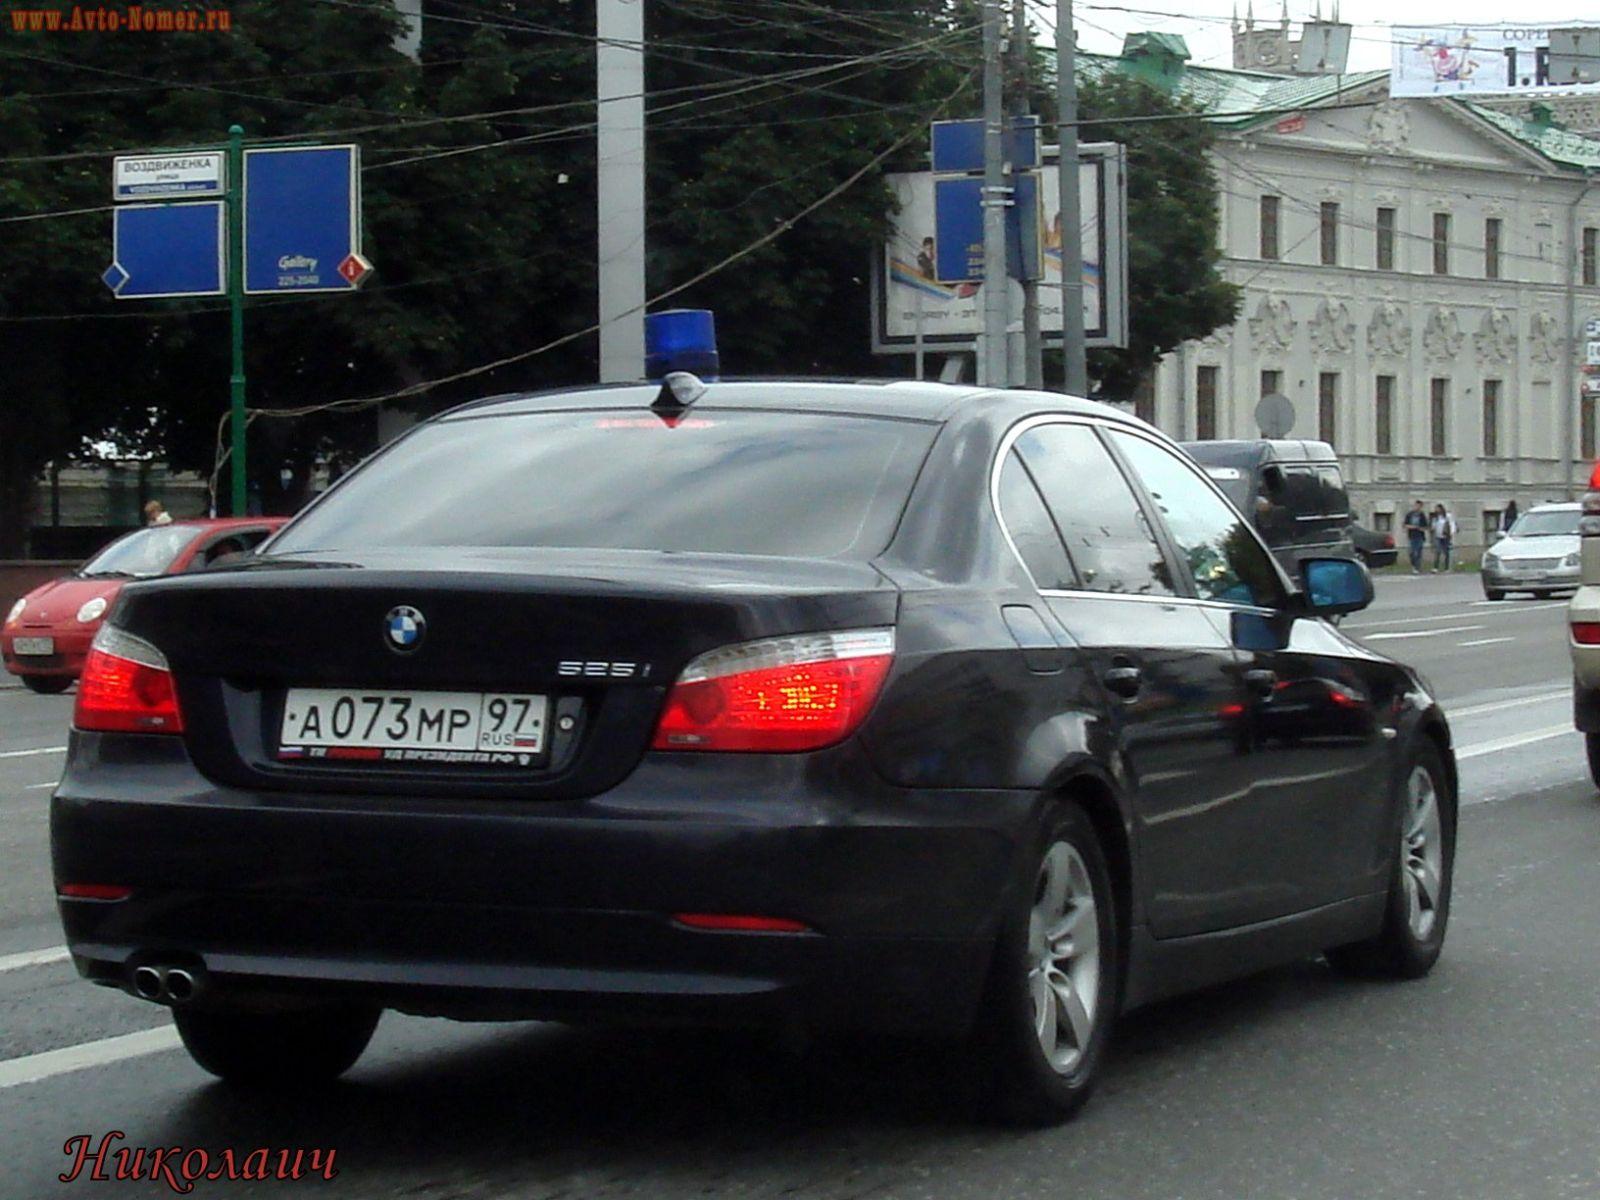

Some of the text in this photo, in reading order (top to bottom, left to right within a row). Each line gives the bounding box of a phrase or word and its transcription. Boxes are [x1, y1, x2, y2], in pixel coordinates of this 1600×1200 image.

[124, 158, 212, 173] ВОЗДВИЖЕНКА
[488, 698, 531, 732] 97
[481, 733, 514, 746] RUS
